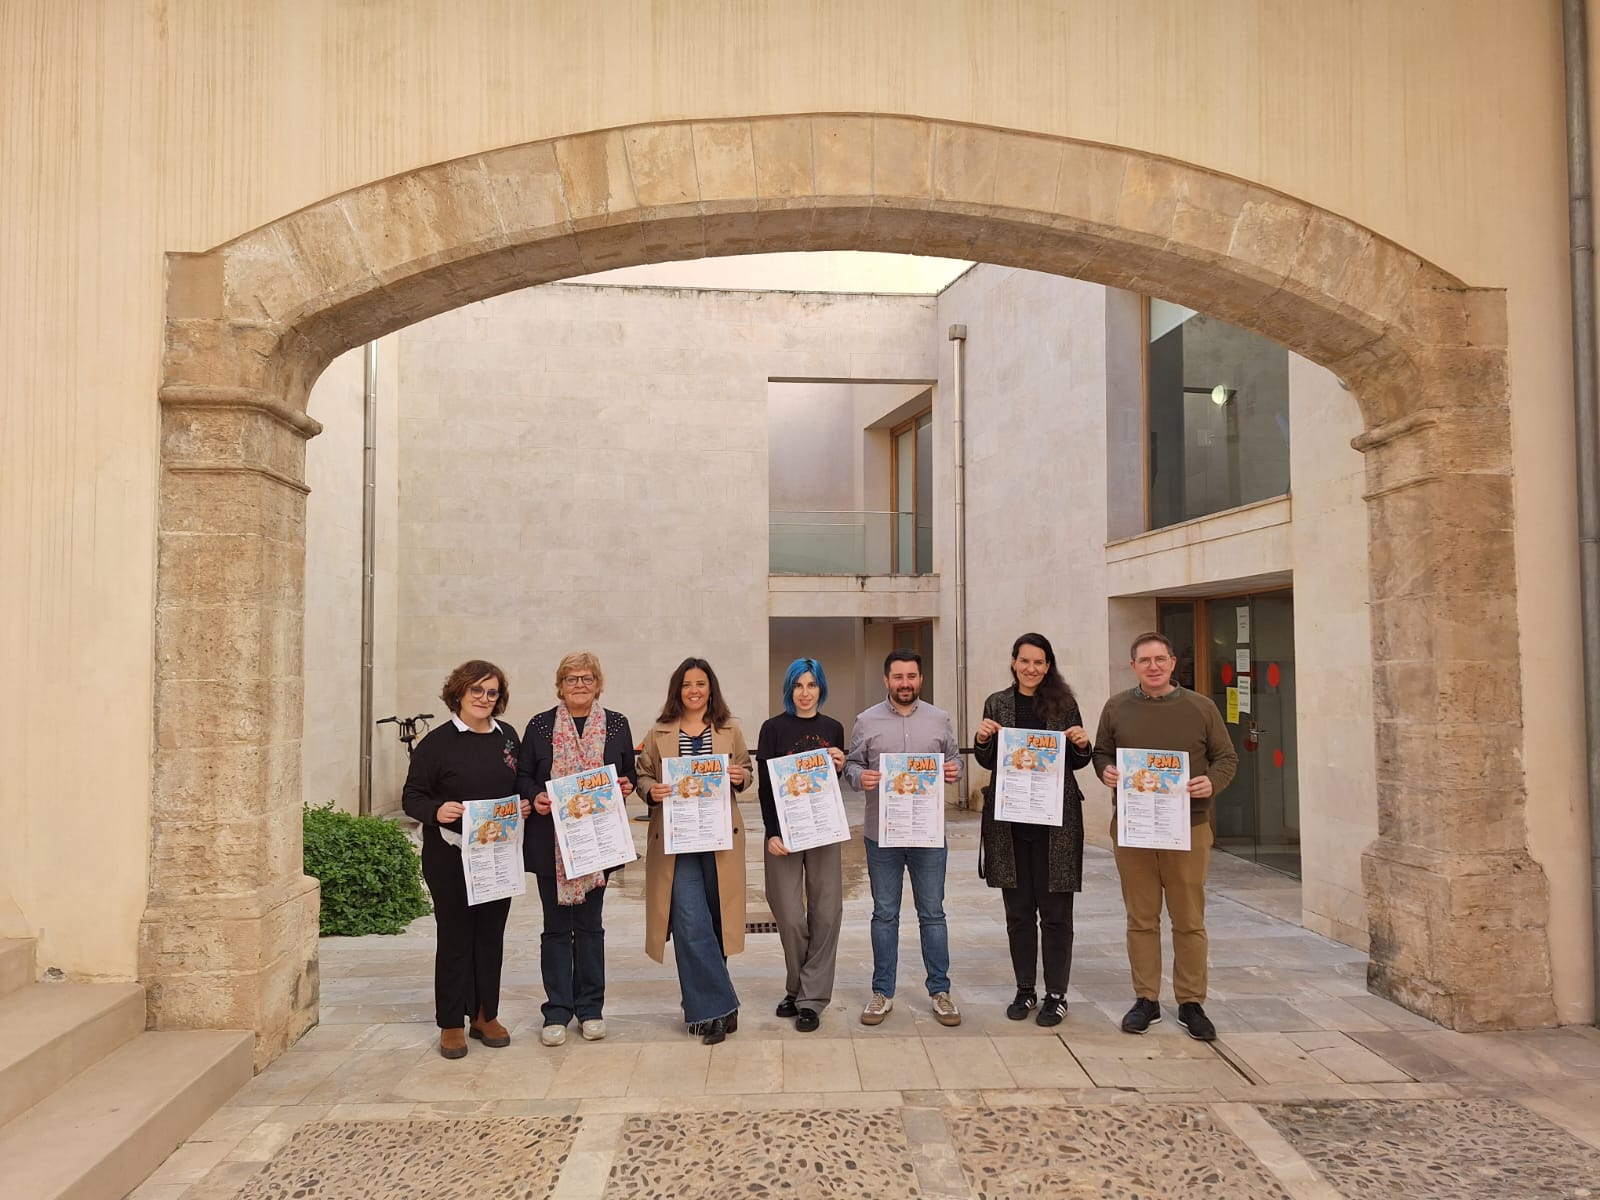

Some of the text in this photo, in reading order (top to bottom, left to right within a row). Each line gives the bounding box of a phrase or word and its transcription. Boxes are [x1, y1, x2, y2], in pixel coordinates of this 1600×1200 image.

[1027, 734, 1057, 749] FeMA
[691, 759, 722, 774] FeMA
[795, 754, 826, 771] FeMA
[907, 758, 937, 771] FeMA
[1147, 754, 1181, 769] FeMA
[577, 771, 610, 791] FeMA
[493, 801, 517, 818] FeMA
